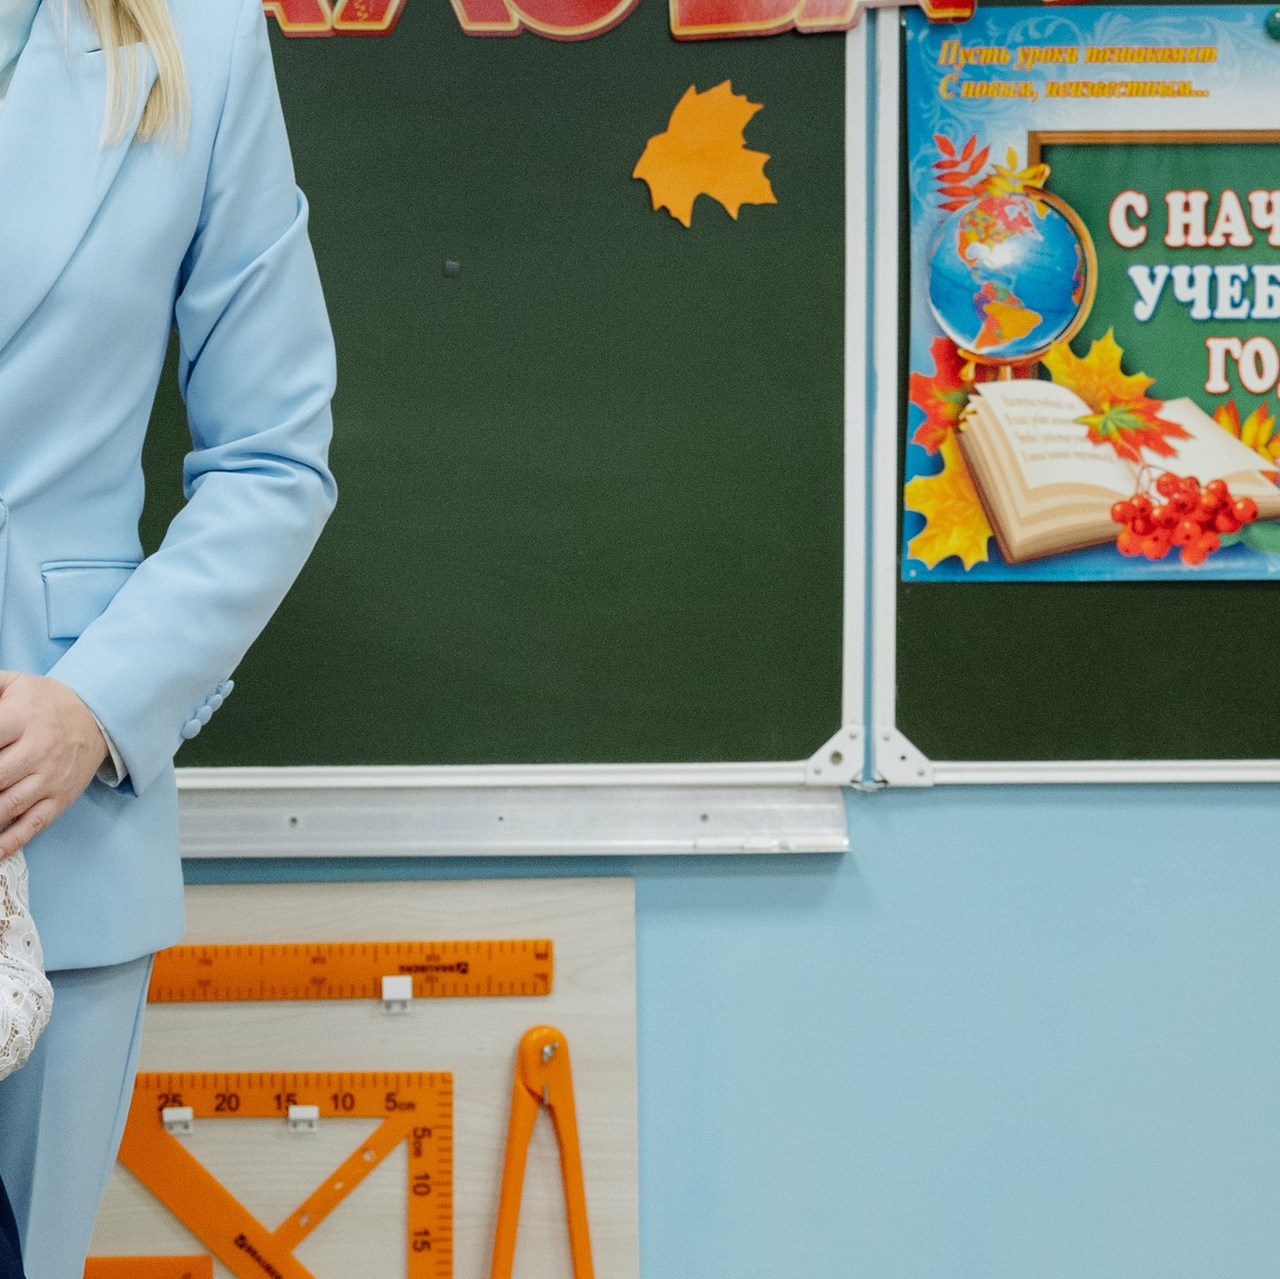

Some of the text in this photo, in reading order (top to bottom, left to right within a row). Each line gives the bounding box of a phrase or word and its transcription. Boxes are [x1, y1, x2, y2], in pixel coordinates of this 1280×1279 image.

[937, 40, 1010, 71] Пусть
[1014, 46, 1079, 71] уроки
[939, 74, 959, 100] С
[1109, 188, 1150, 249] С
[1204, 335, 1280, 396] ГО
[214, 1093, 240, 1112] 20
[274, 1093, 299, 1111] 15
[331, 1093, 356, 1112] 10
[412, 1173, 432, 1197] 10
[412, 1228, 432, 1253] 15
